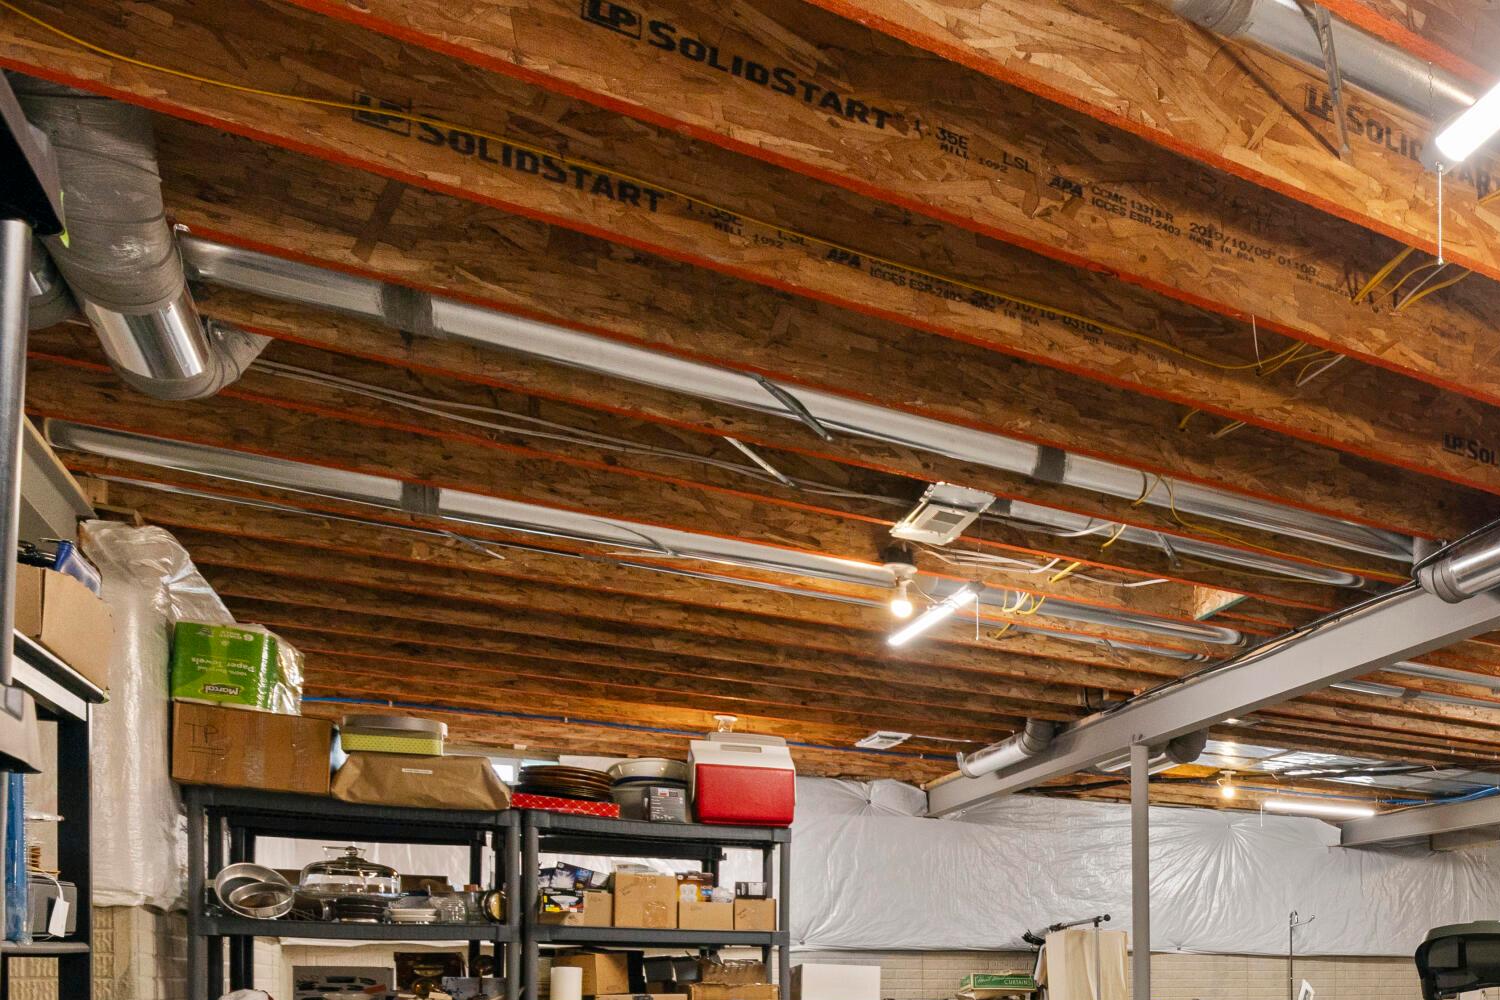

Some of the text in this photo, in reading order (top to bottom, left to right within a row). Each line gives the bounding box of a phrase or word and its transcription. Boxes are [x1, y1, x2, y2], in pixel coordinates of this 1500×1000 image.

[648, 20, 888, 129] SOLIDSTART
[1003, 152, 1035, 174] LSL
[205, 685, 239, 696] Marcal
